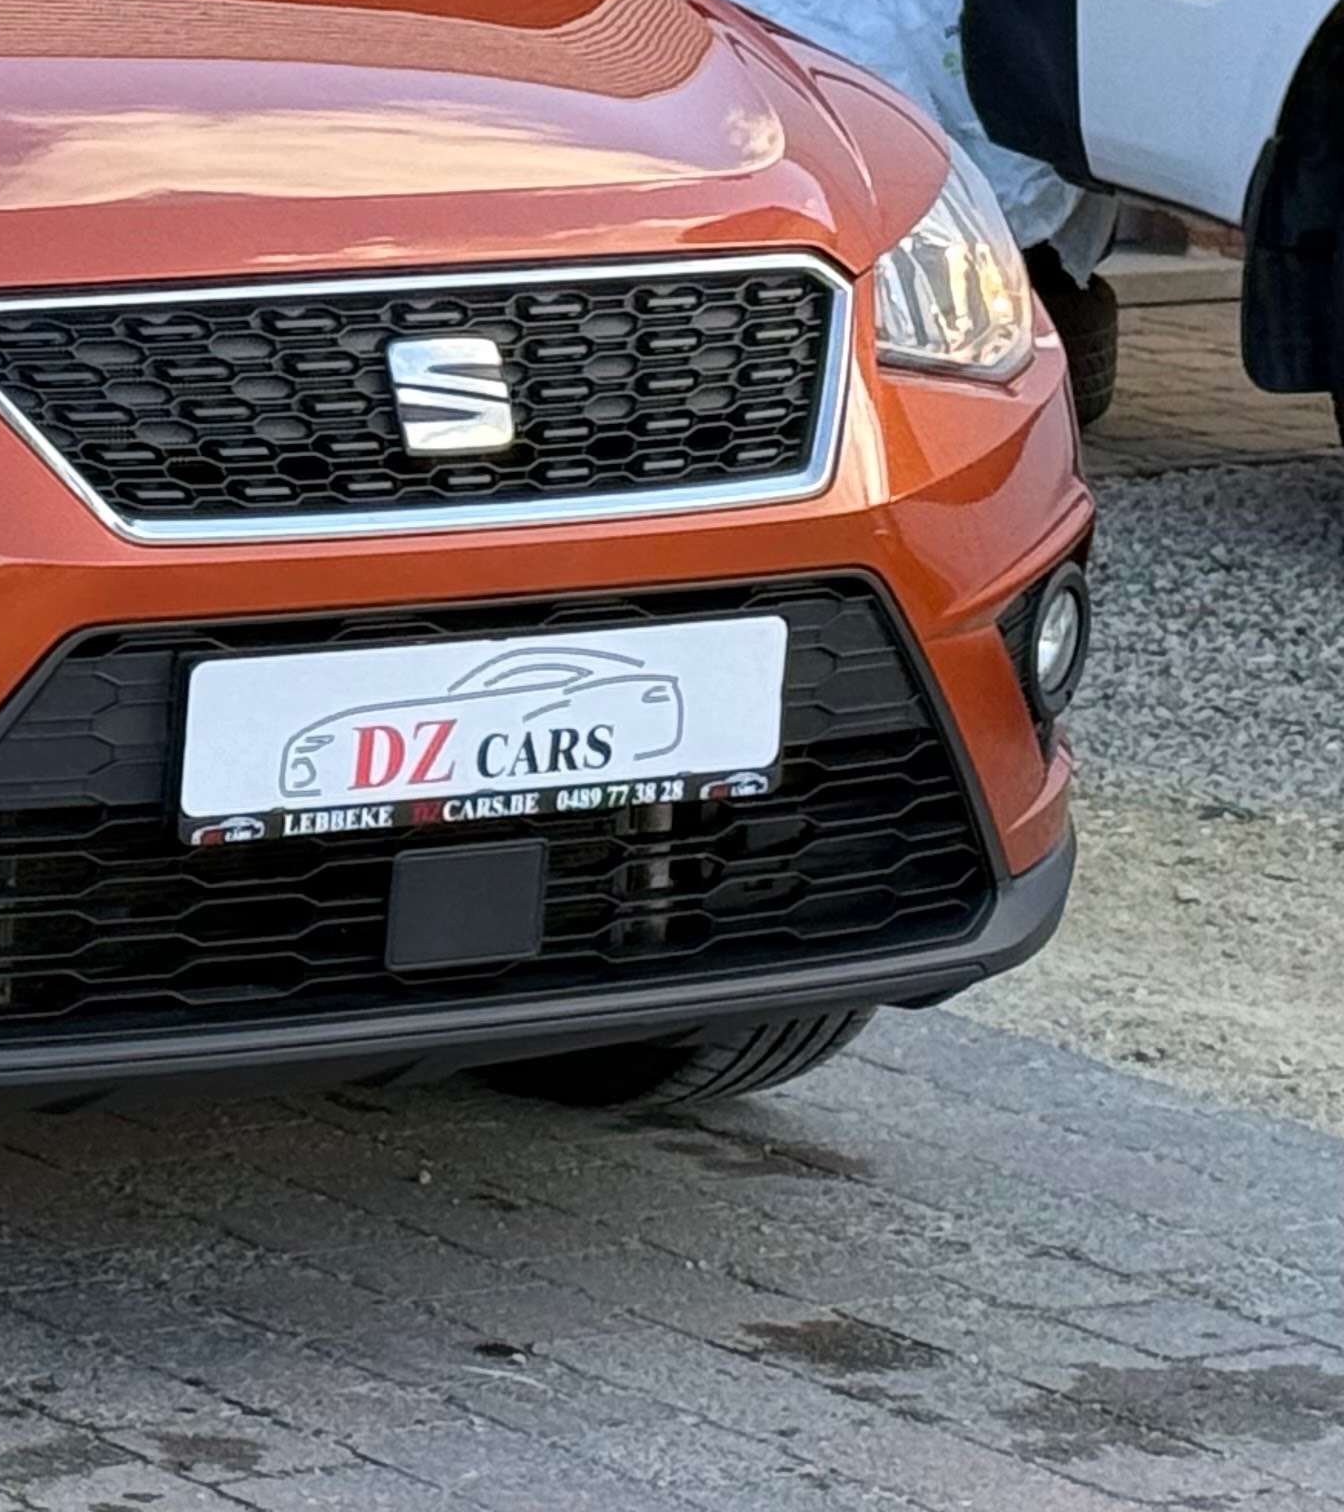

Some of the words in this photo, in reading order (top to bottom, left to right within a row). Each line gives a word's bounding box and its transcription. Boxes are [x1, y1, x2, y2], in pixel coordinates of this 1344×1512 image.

[349, 719, 457, 790] DZ
[476, 724, 614, 780] CARS
[283, 805, 394, 836] LEBBEKE
[607, 785, 631, 807] 77
[633, 783, 658, 804] 38
[660, 781, 685, 801] 28
